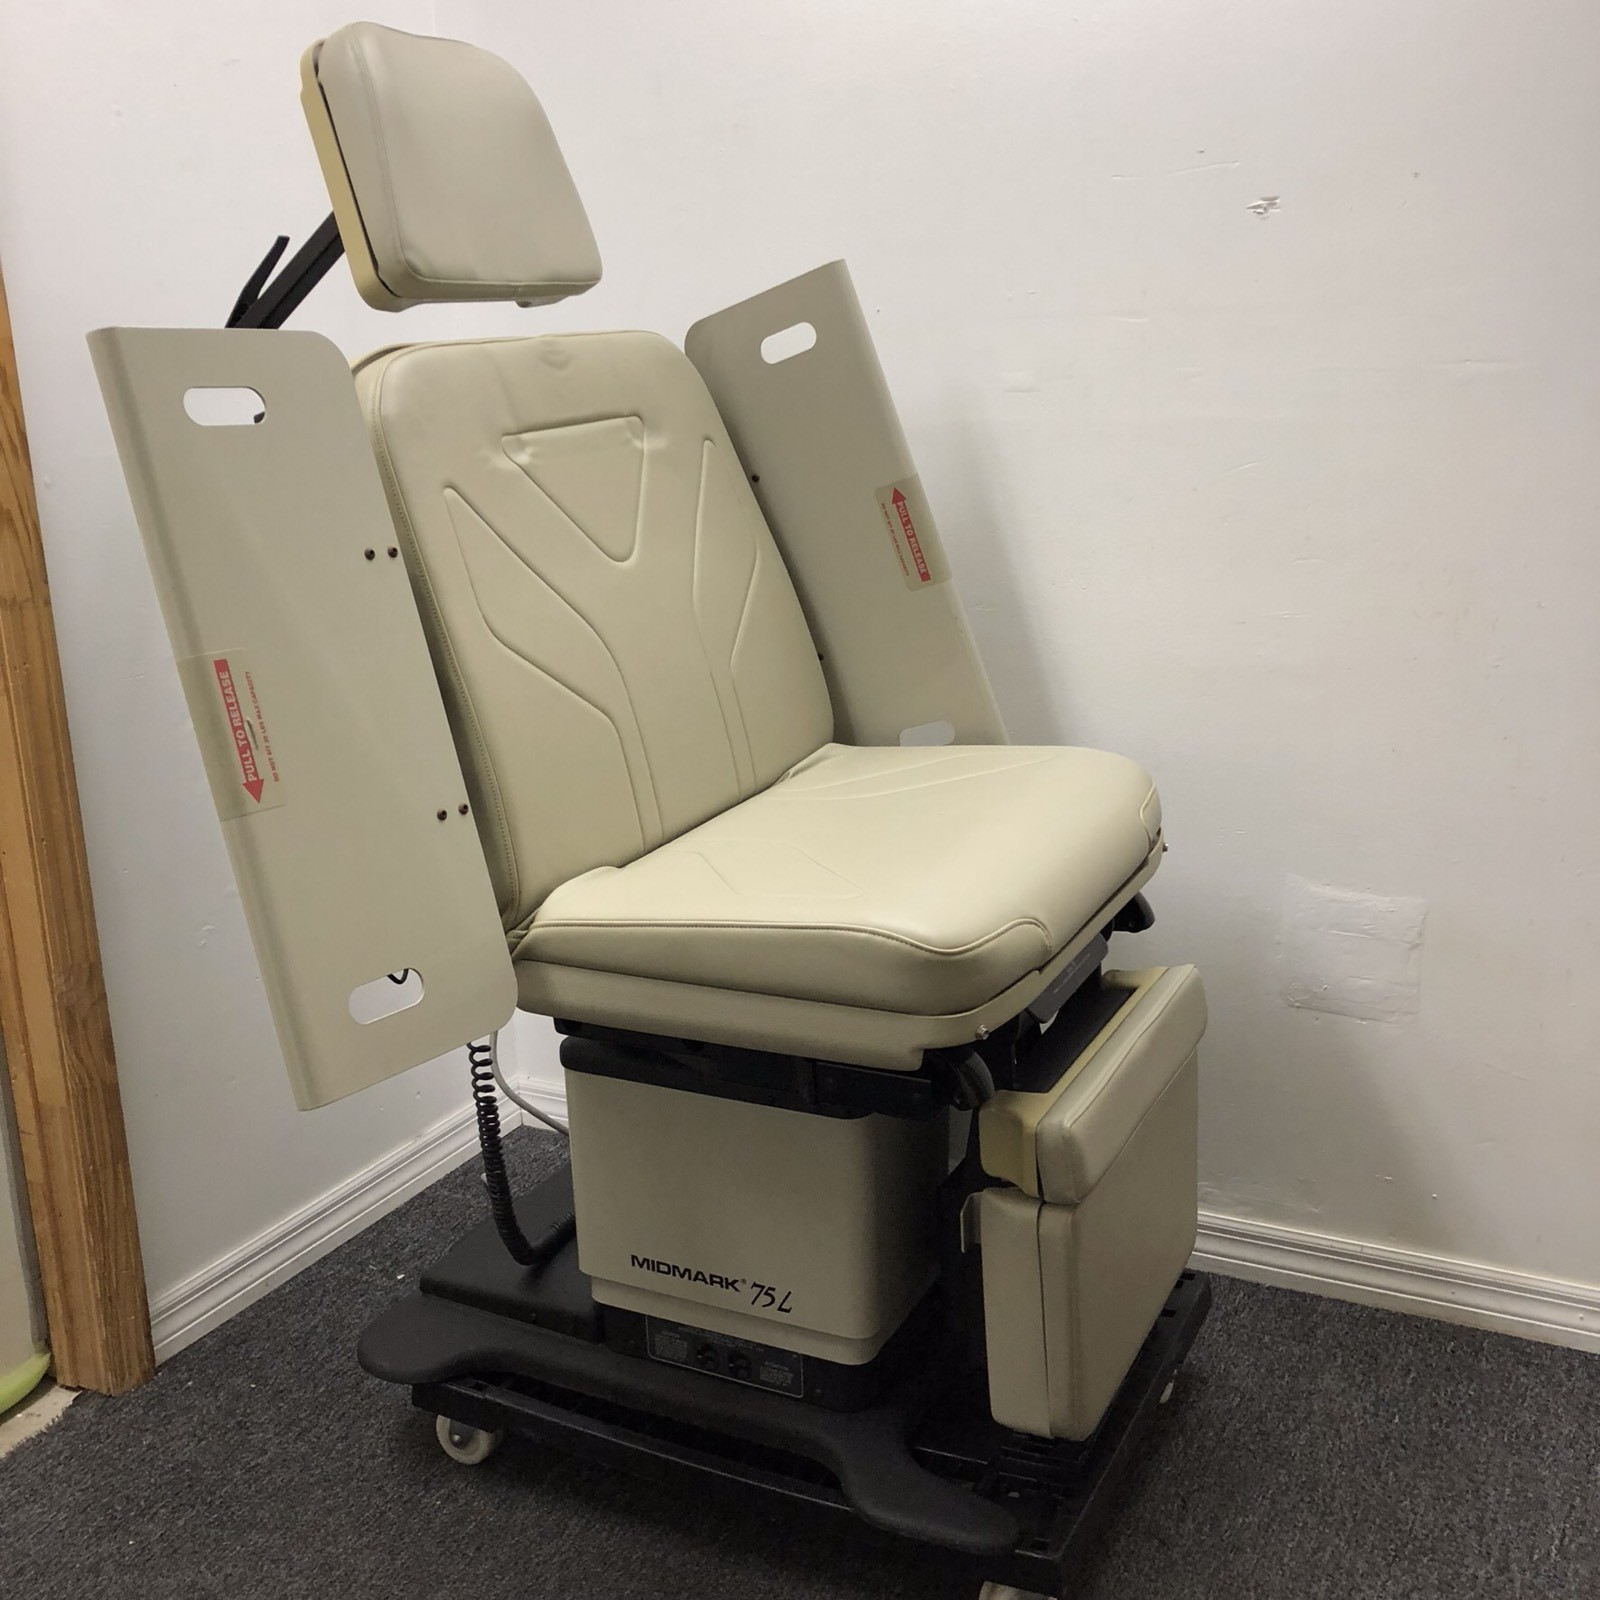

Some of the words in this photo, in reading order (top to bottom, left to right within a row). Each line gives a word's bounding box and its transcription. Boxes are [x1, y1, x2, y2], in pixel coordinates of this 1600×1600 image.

[897, 501, 909, 523] PULL
[904, 524, 915, 536] TO
[909, 537, 927, 574] RELEASE
[219, 670, 242, 727] RELEASE
[245, 671, 258, 704] CAPACITY
[236, 729, 247, 748] TO
[241, 749, 258, 782] PULL
[271, 771, 279, 782] DO
[630, 1254, 740, 1292] MIDMARK
